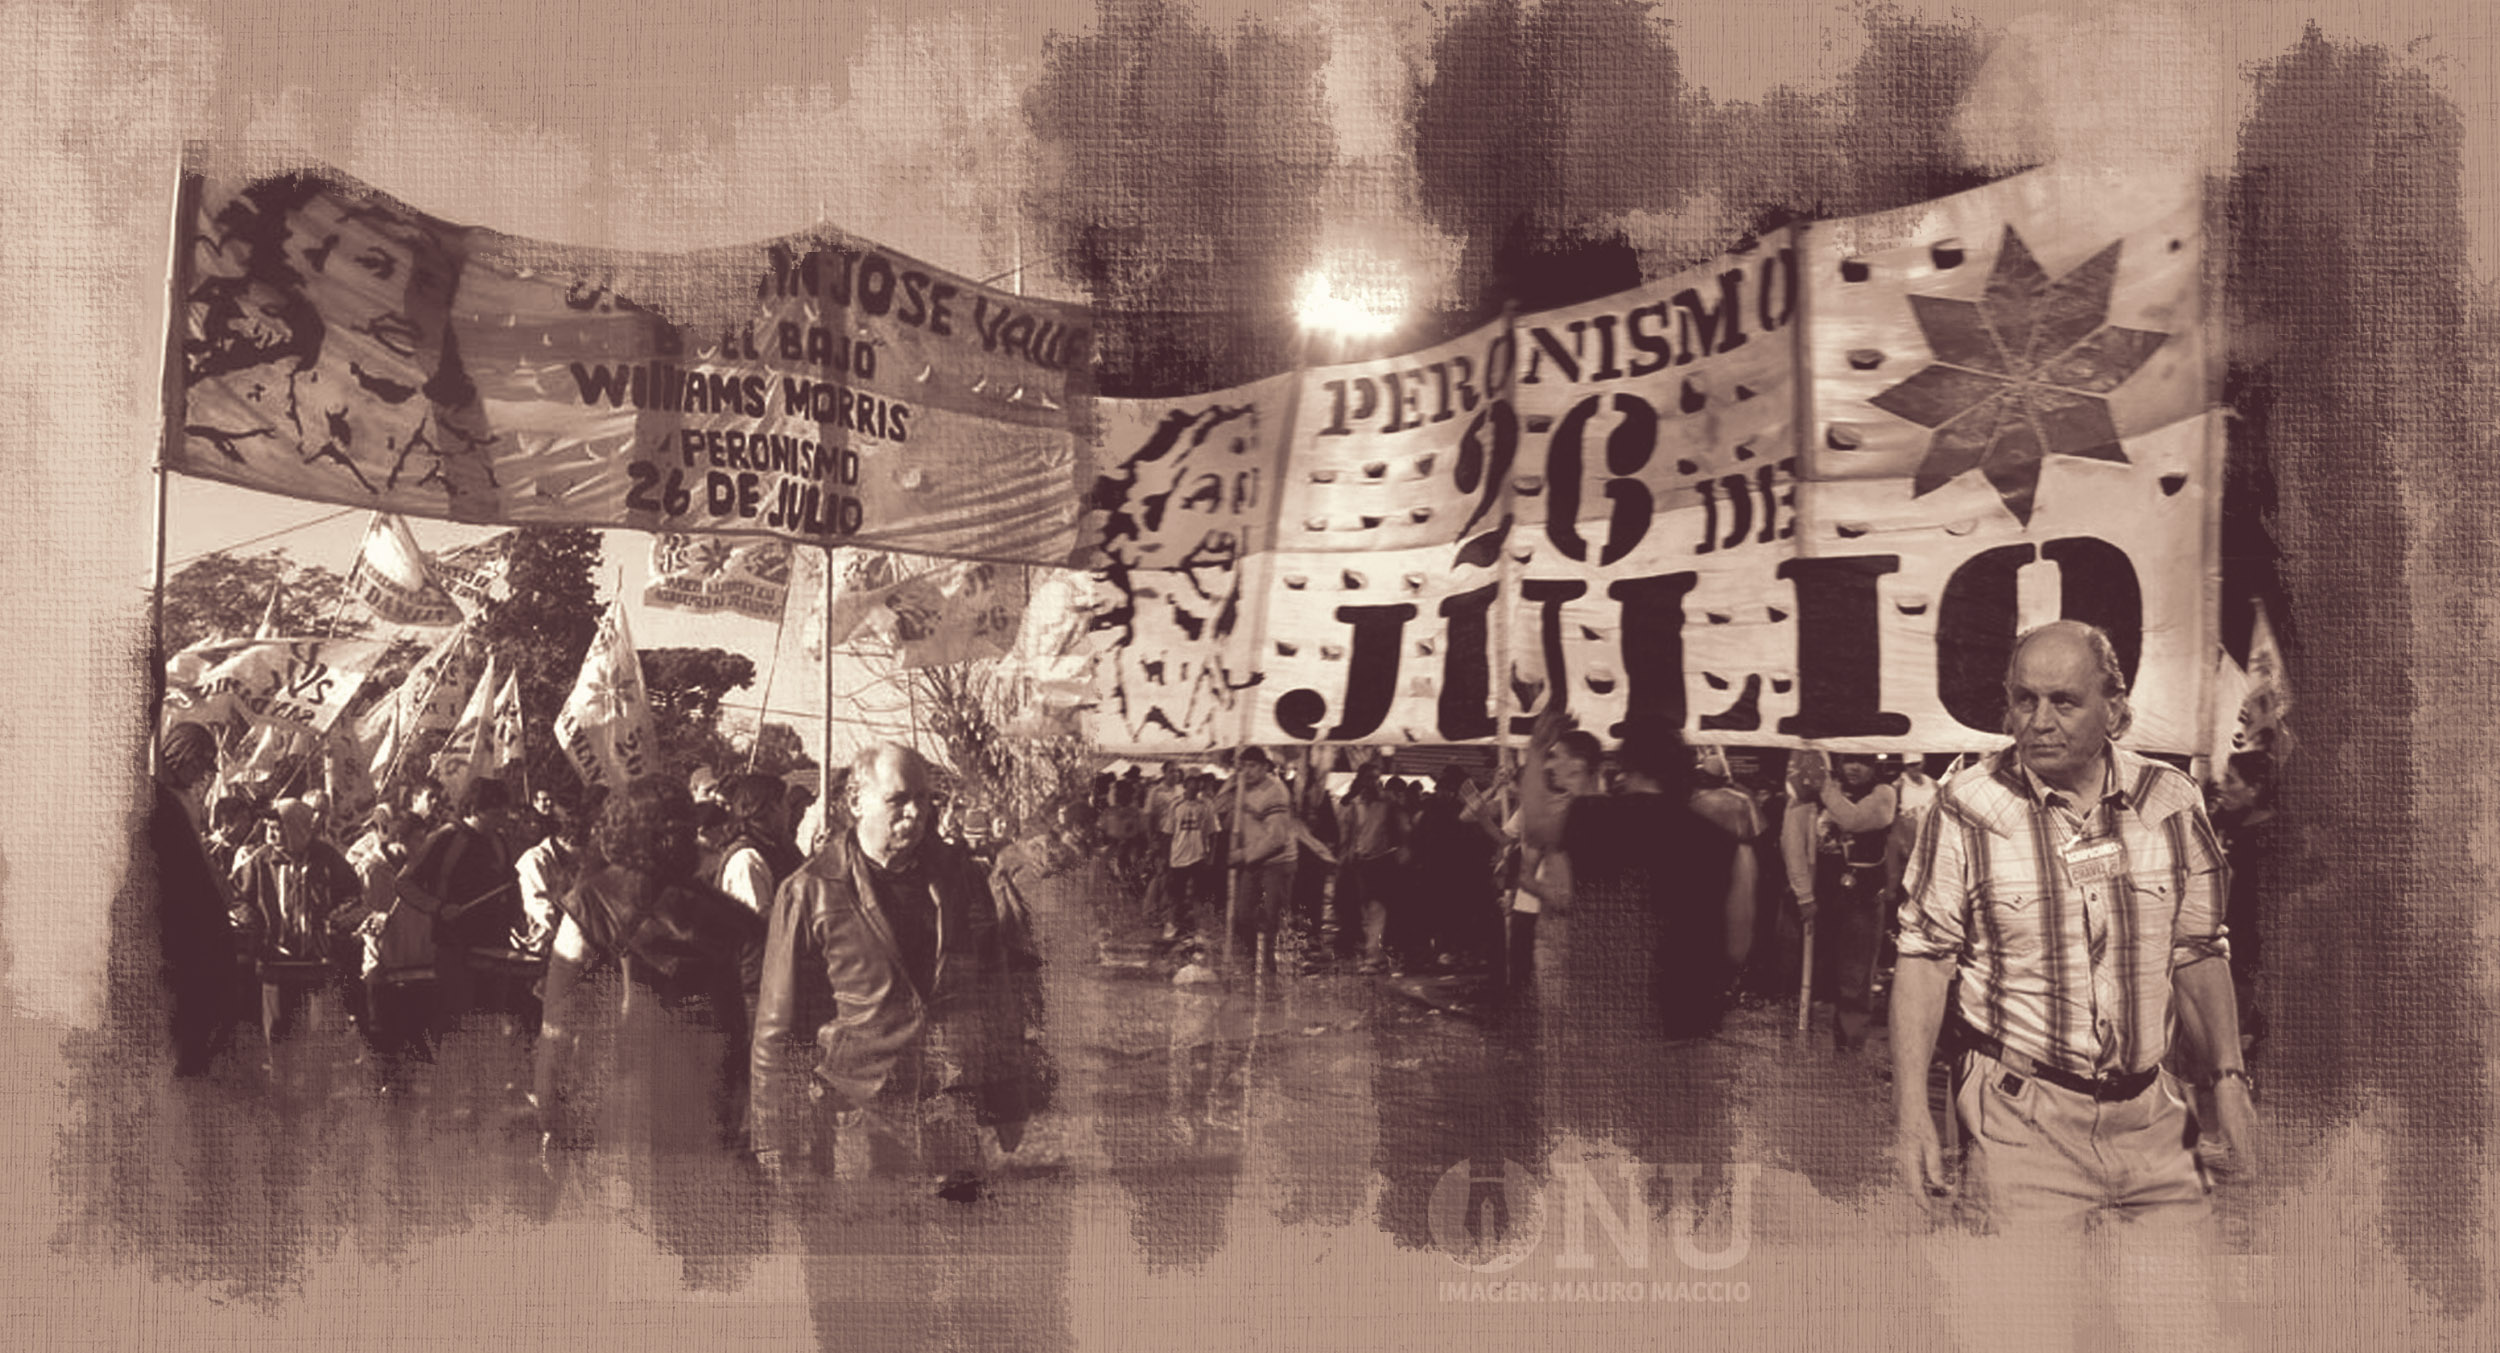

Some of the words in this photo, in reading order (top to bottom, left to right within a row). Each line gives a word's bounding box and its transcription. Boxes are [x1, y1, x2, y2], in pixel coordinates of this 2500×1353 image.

[778, 321, 876, 380] BAJO
[1319, 249, 1798, 436] PERONISMO
[569, 362, 767, 420] WILLIAMS
[783, 376, 910, 443] MORRIS
[625, 462, 693, 515] 26
[706, 472, 761, 519] DE
[766, 481, 865, 536] JULIO
[682, 430, 860, 487] PERONISMO
[1450, 393, 1659, 570] 26
[1275, 535, 2143, 741] JULIO
